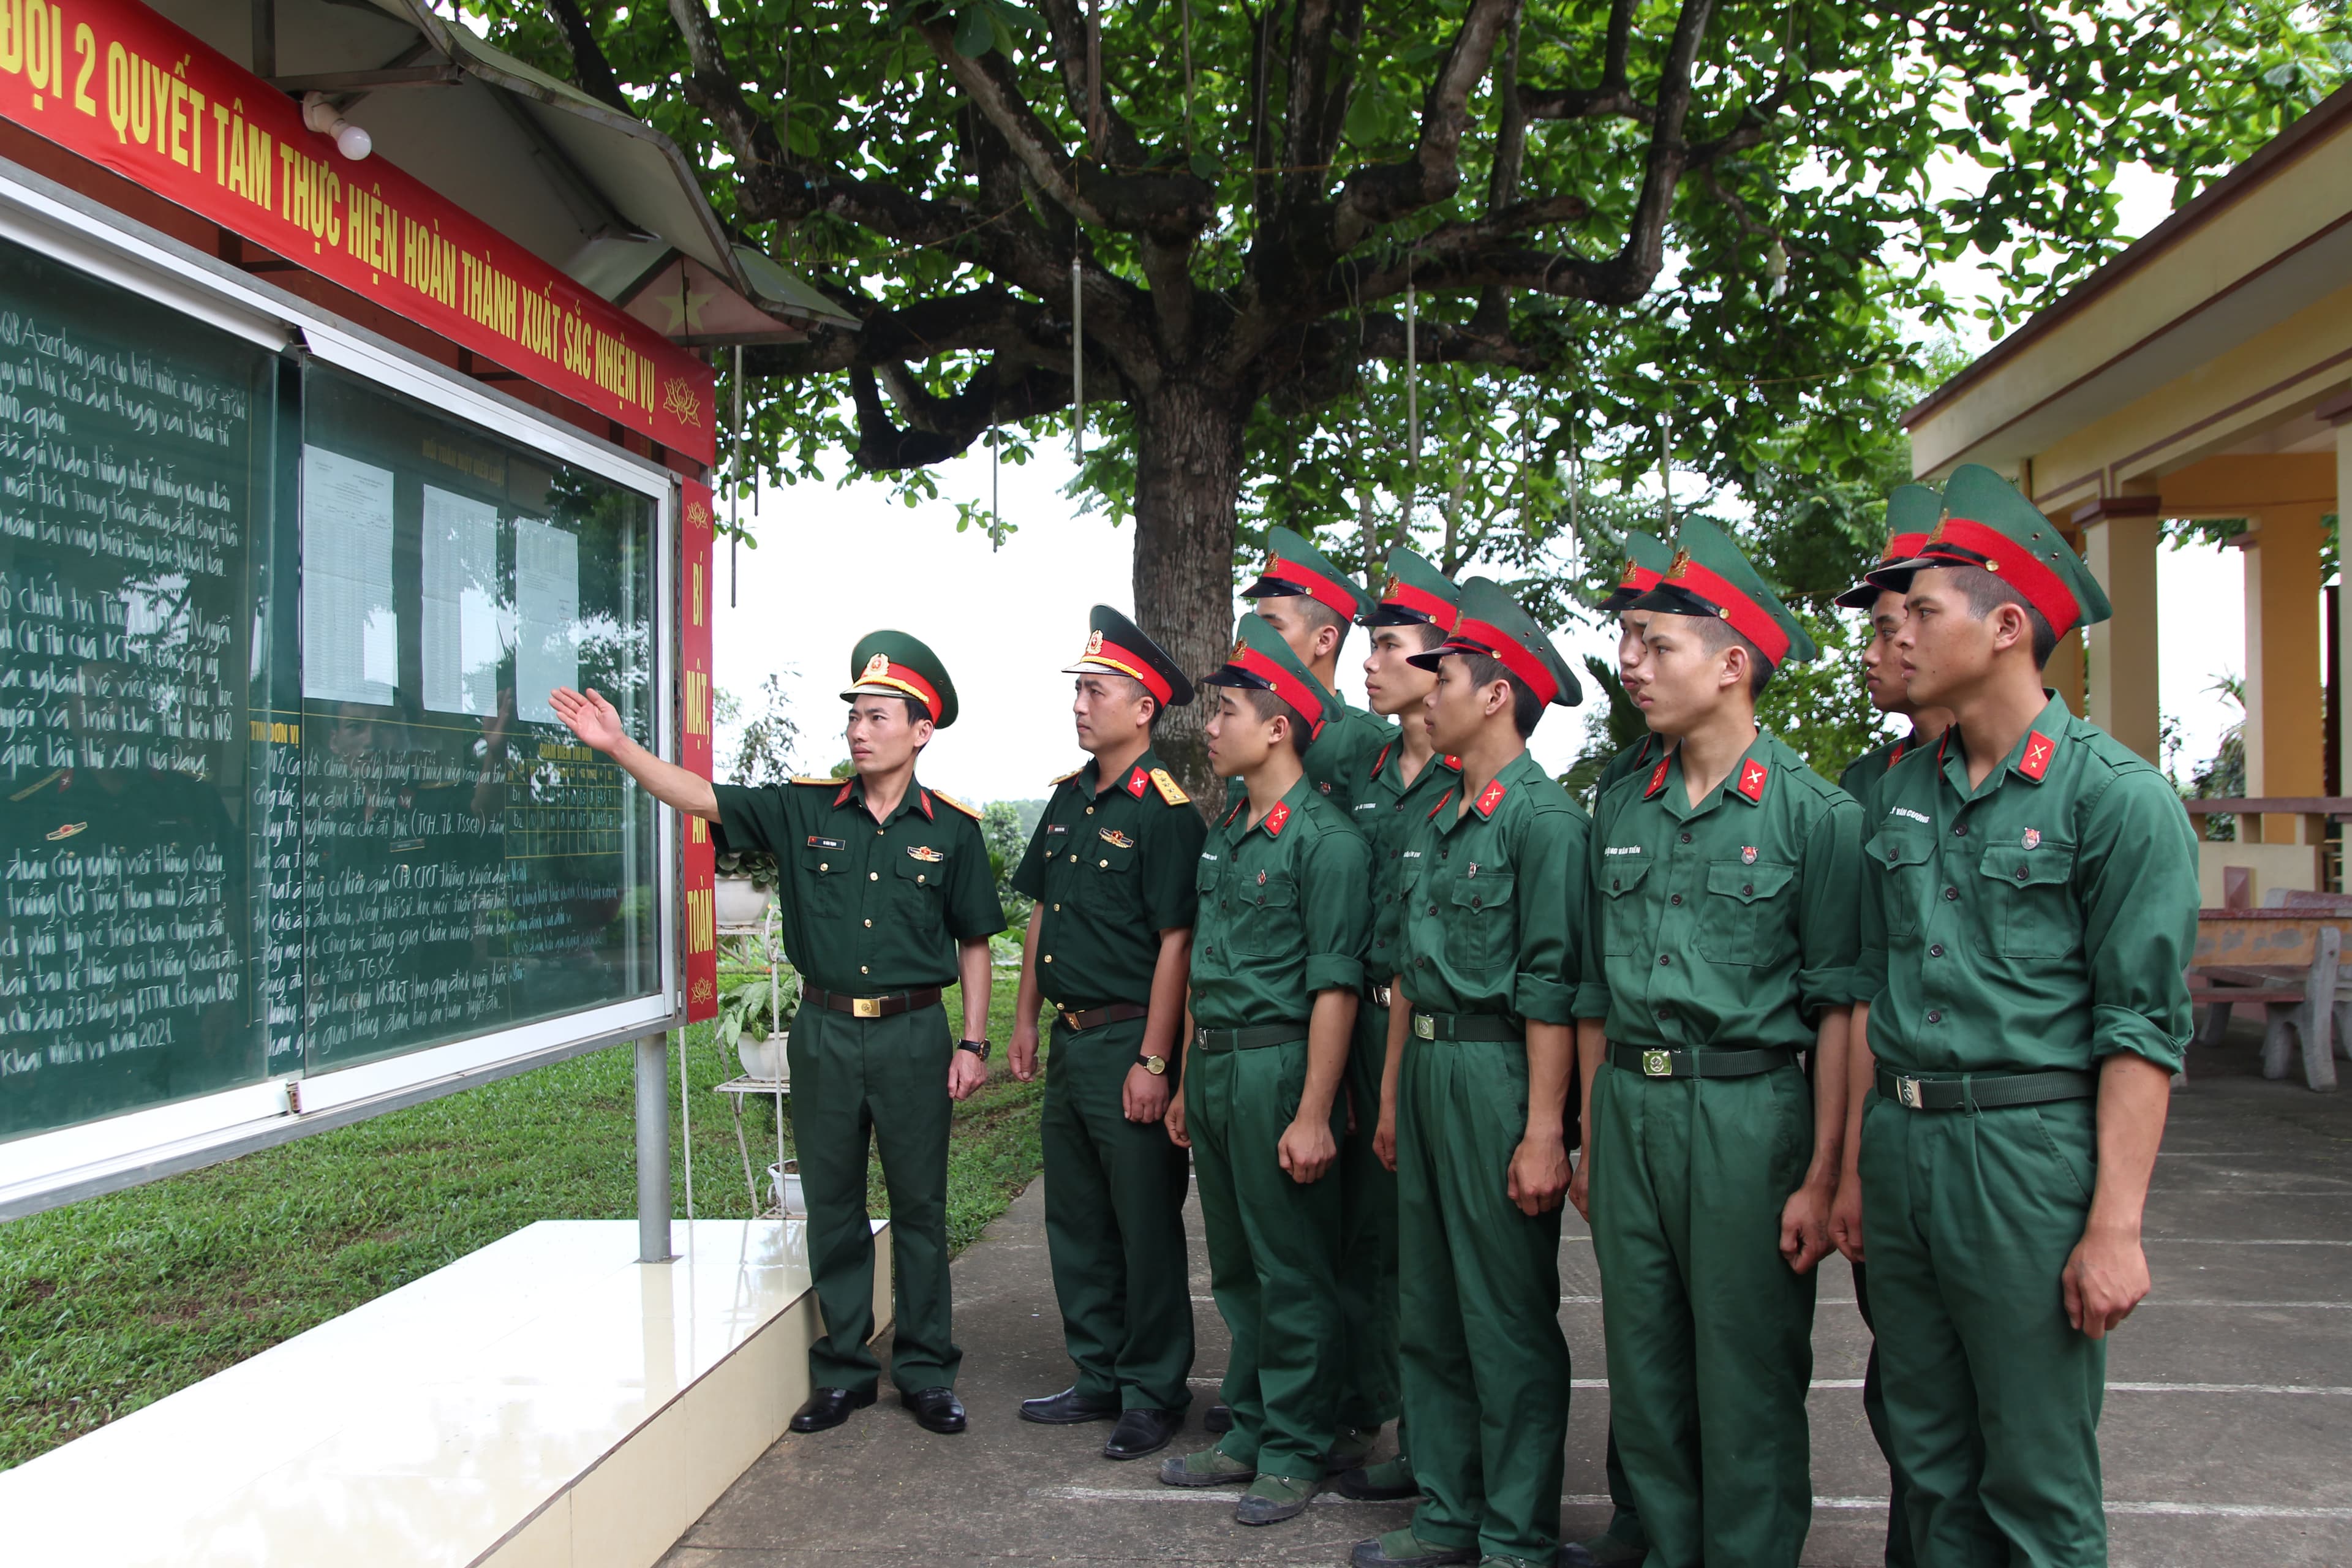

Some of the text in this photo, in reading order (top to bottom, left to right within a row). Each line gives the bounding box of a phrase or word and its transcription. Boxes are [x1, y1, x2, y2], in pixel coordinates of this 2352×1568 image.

[75, 23, 96, 116] 2
[108, 41, 205, 174] QUYẾT
[214, 97, 271, 211] TÂM
[281, 141, 341, 255] THỰC
[349, 183, 398, 285] HIỆN
[404, 217, 456, 308] HOÀN
[462, 250, 517, 341] THÀNH
[521, 281, 560, 363] XUẤT
[564, 299, 591, 380] SẮC
[595, 330, 636, 410] NHIỆM
[640, 356, 655, 425] VỤ
[0, 311, 19, 345] QP
[693, 551, 703, 627] BÍ
[290, 725, 299, 748] VỊ
[687, 875, 714, 955] TOÀN
[66, 995, 84, 1025] 35
